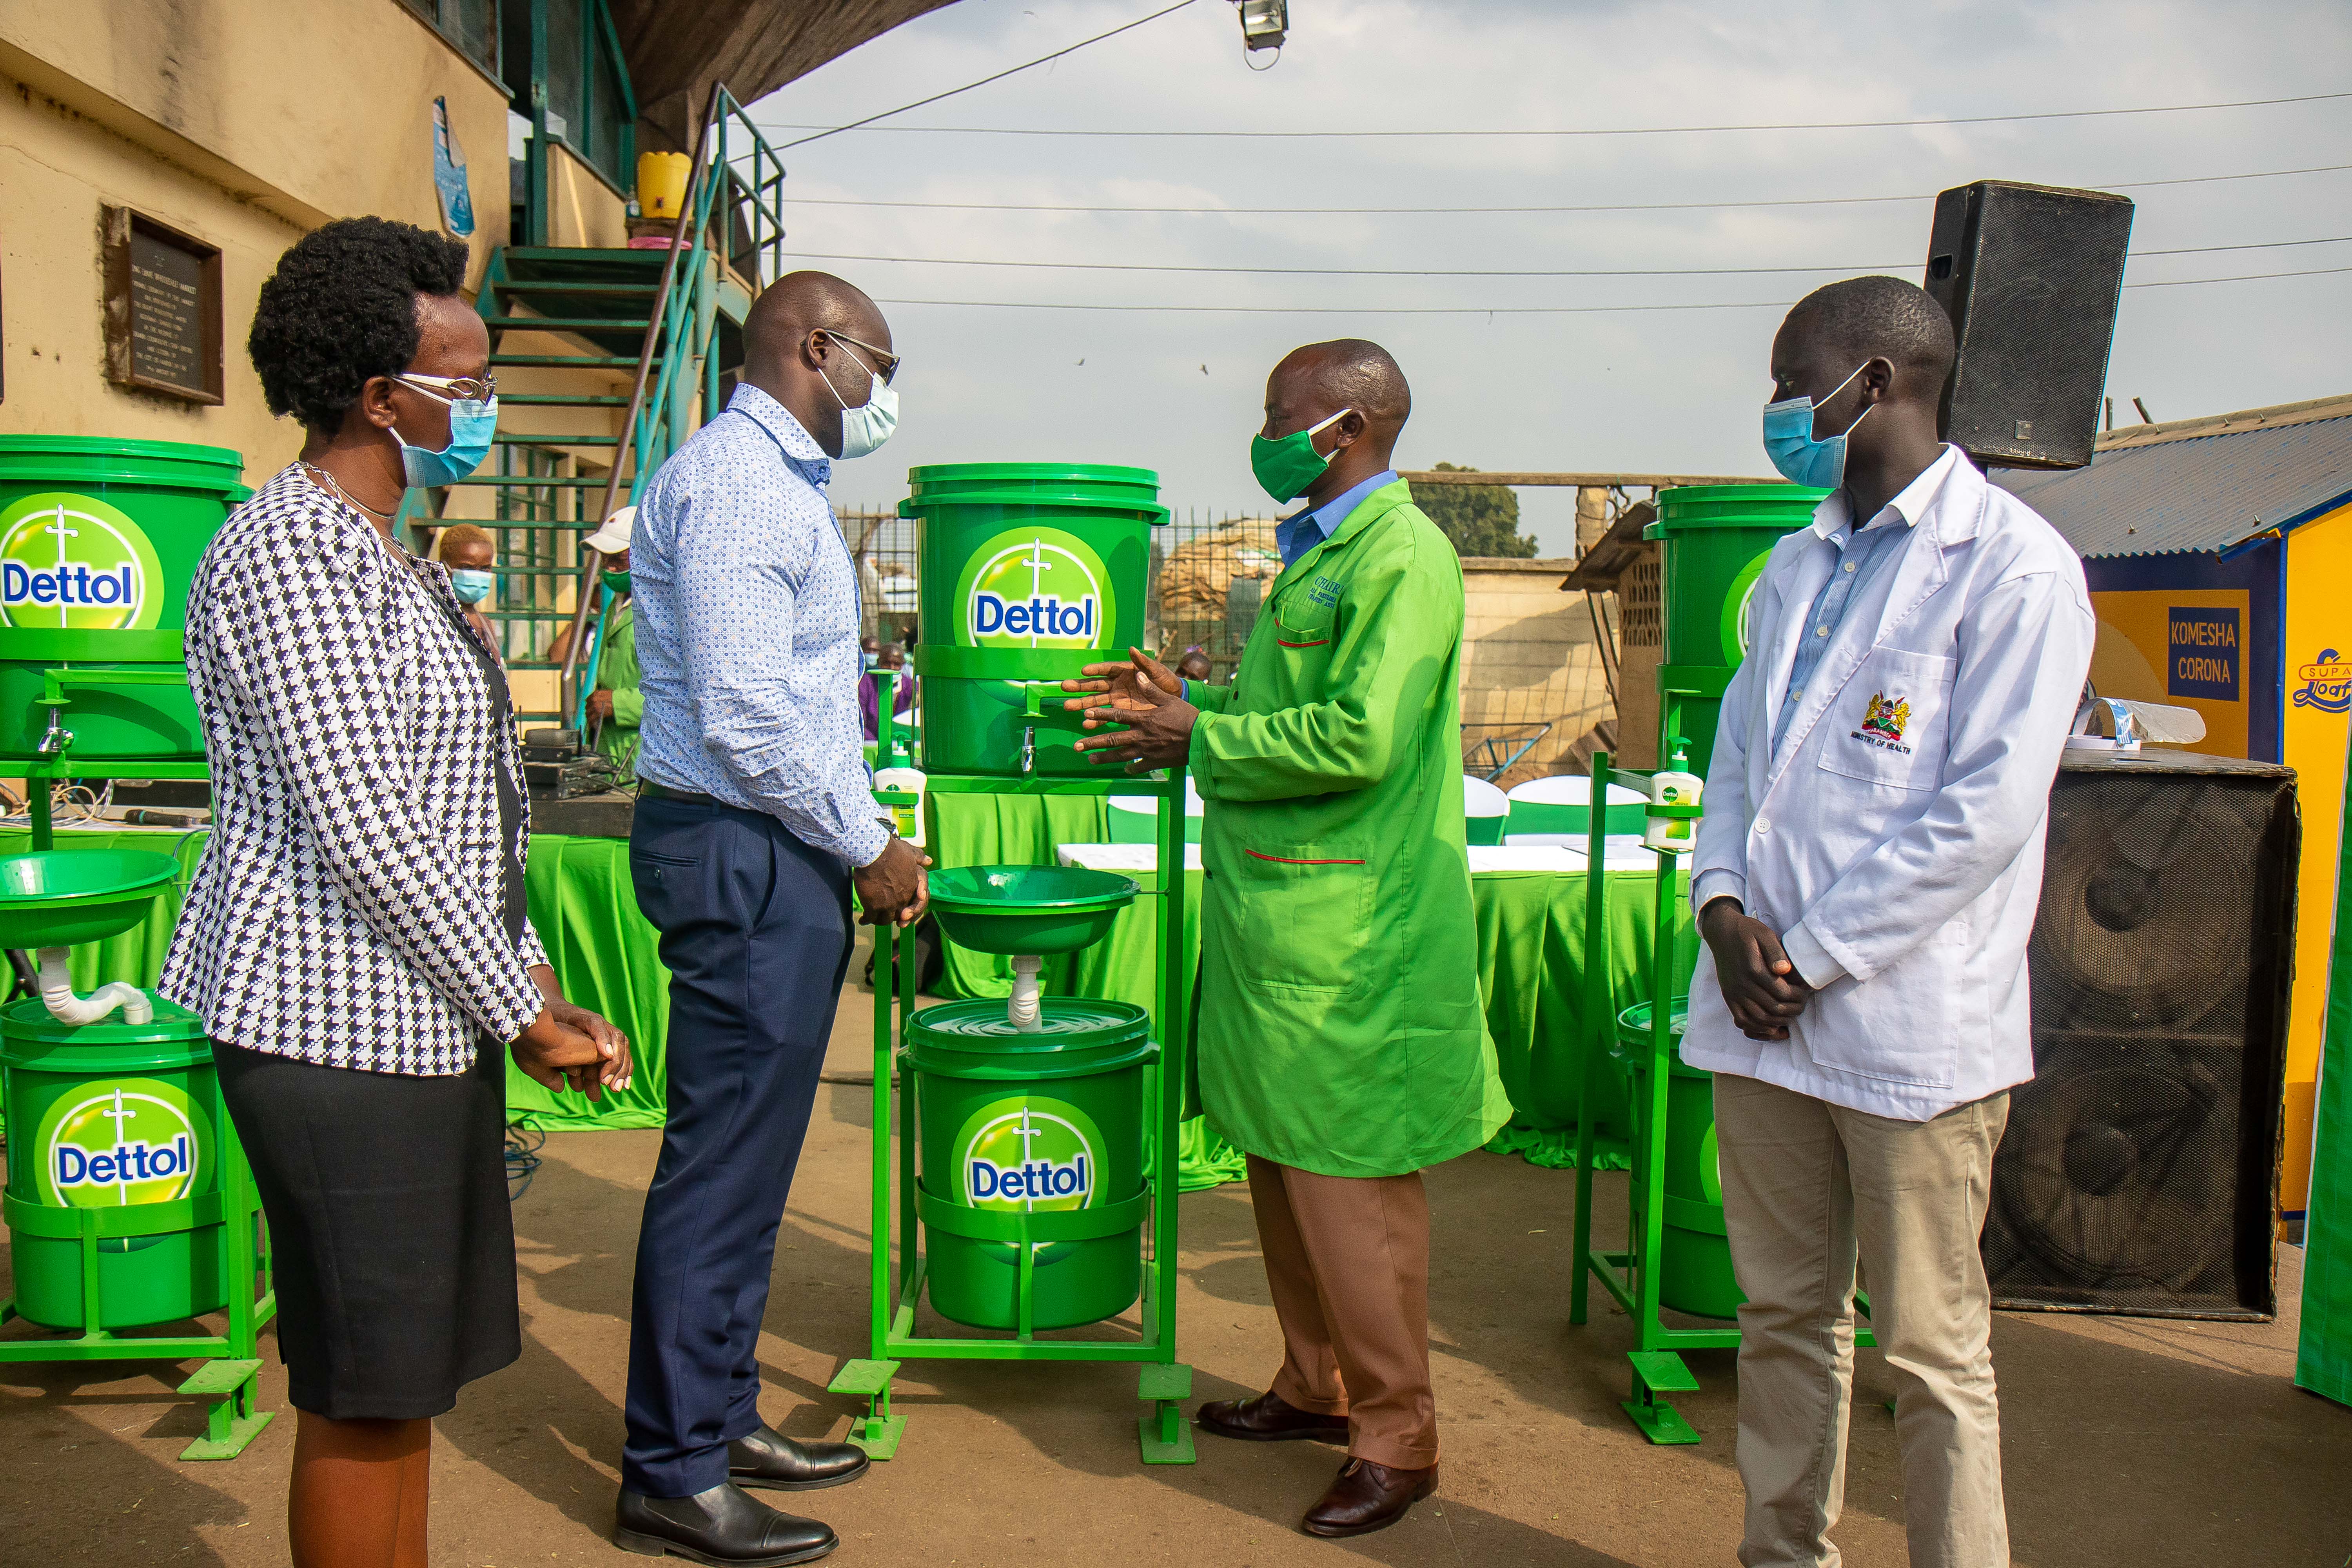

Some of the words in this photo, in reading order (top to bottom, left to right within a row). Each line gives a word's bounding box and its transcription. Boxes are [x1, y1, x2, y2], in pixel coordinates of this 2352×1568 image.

[3, 563, 131, 604] Dettol
[976, 595, 1092, 635] Dettol
[2171, 621, 2236, 647] KOMESHA
[2178, 657, 2231, 684] CORONA
[2309, 667, 2351, 677] SUPA
[1850, 731, 1875, 745] MINISTRY
[1886, 742, 1911, 755] HEALTH
[58, 1137, 187, 1183] Dettol
[972, 1156, 1085, 1198] Dettol
